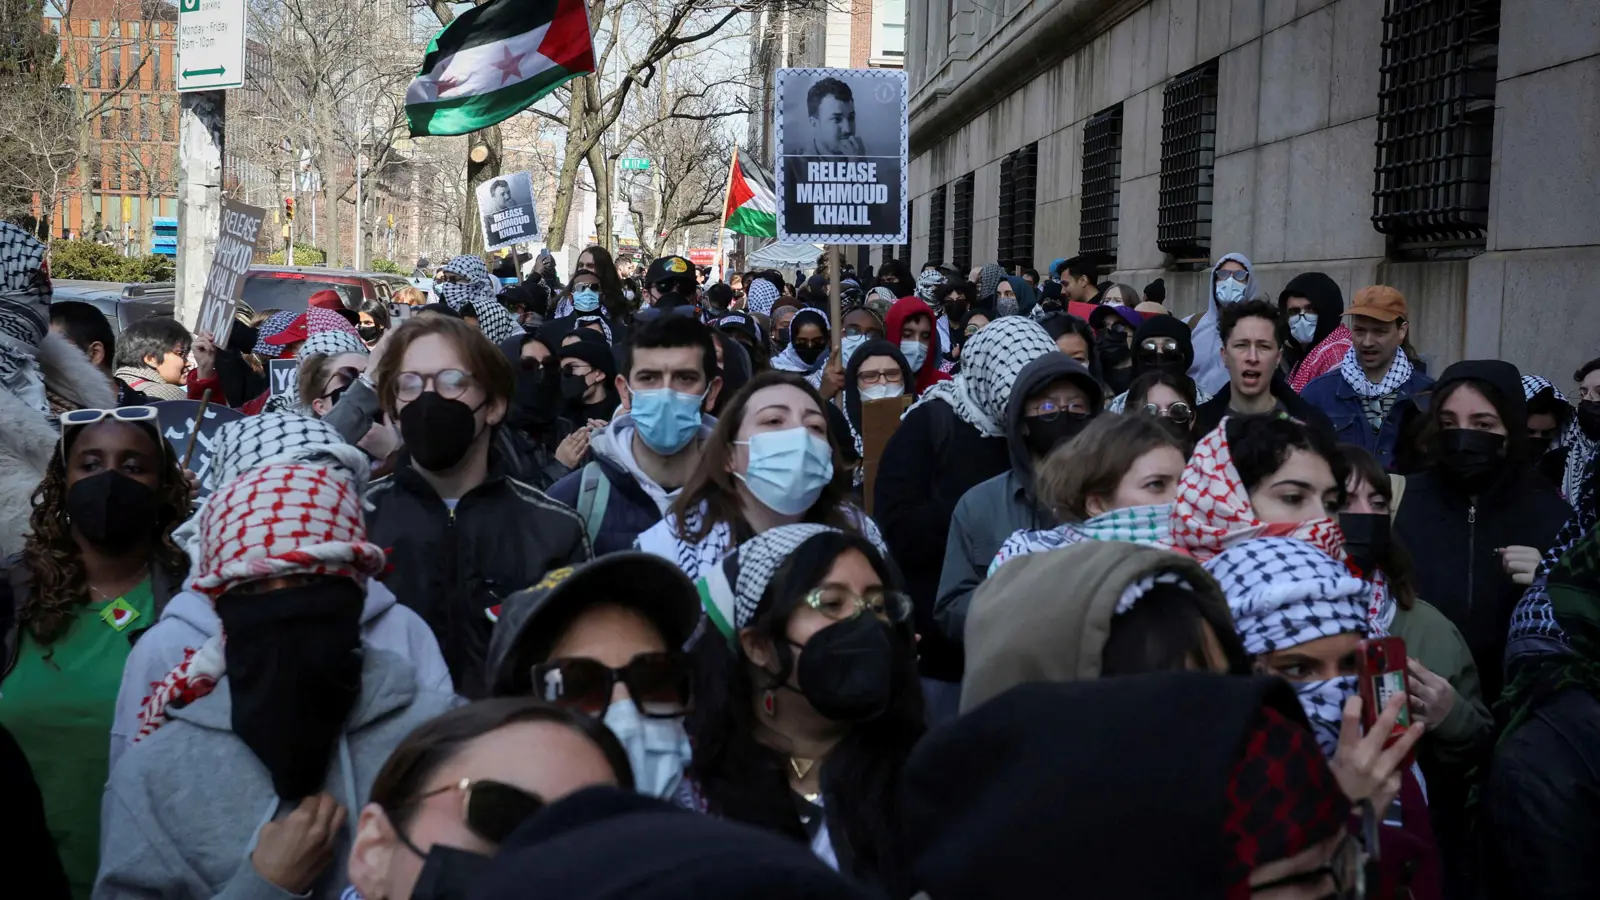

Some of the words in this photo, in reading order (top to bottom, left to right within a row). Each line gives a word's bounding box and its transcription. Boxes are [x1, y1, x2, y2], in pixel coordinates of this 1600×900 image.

[182, 25, 204, 36] Monday
[210, 21, 228, 33] Friday
[807, 161, 877, 183] RELEASE
[796, 183, 888, 204] MAHMOUD
[490, 214, 530, 233] MAHMOUD
[493, 207, 524, 223] RELEASE
[813, 204, 871, 226] KHALIL
[222, 209, 260, 243] RELEASE
[498, 225, 525, 240] KHALIL
[206, 264, 238, 305] KHALIL
[199, 294, 236, 346] NOW
